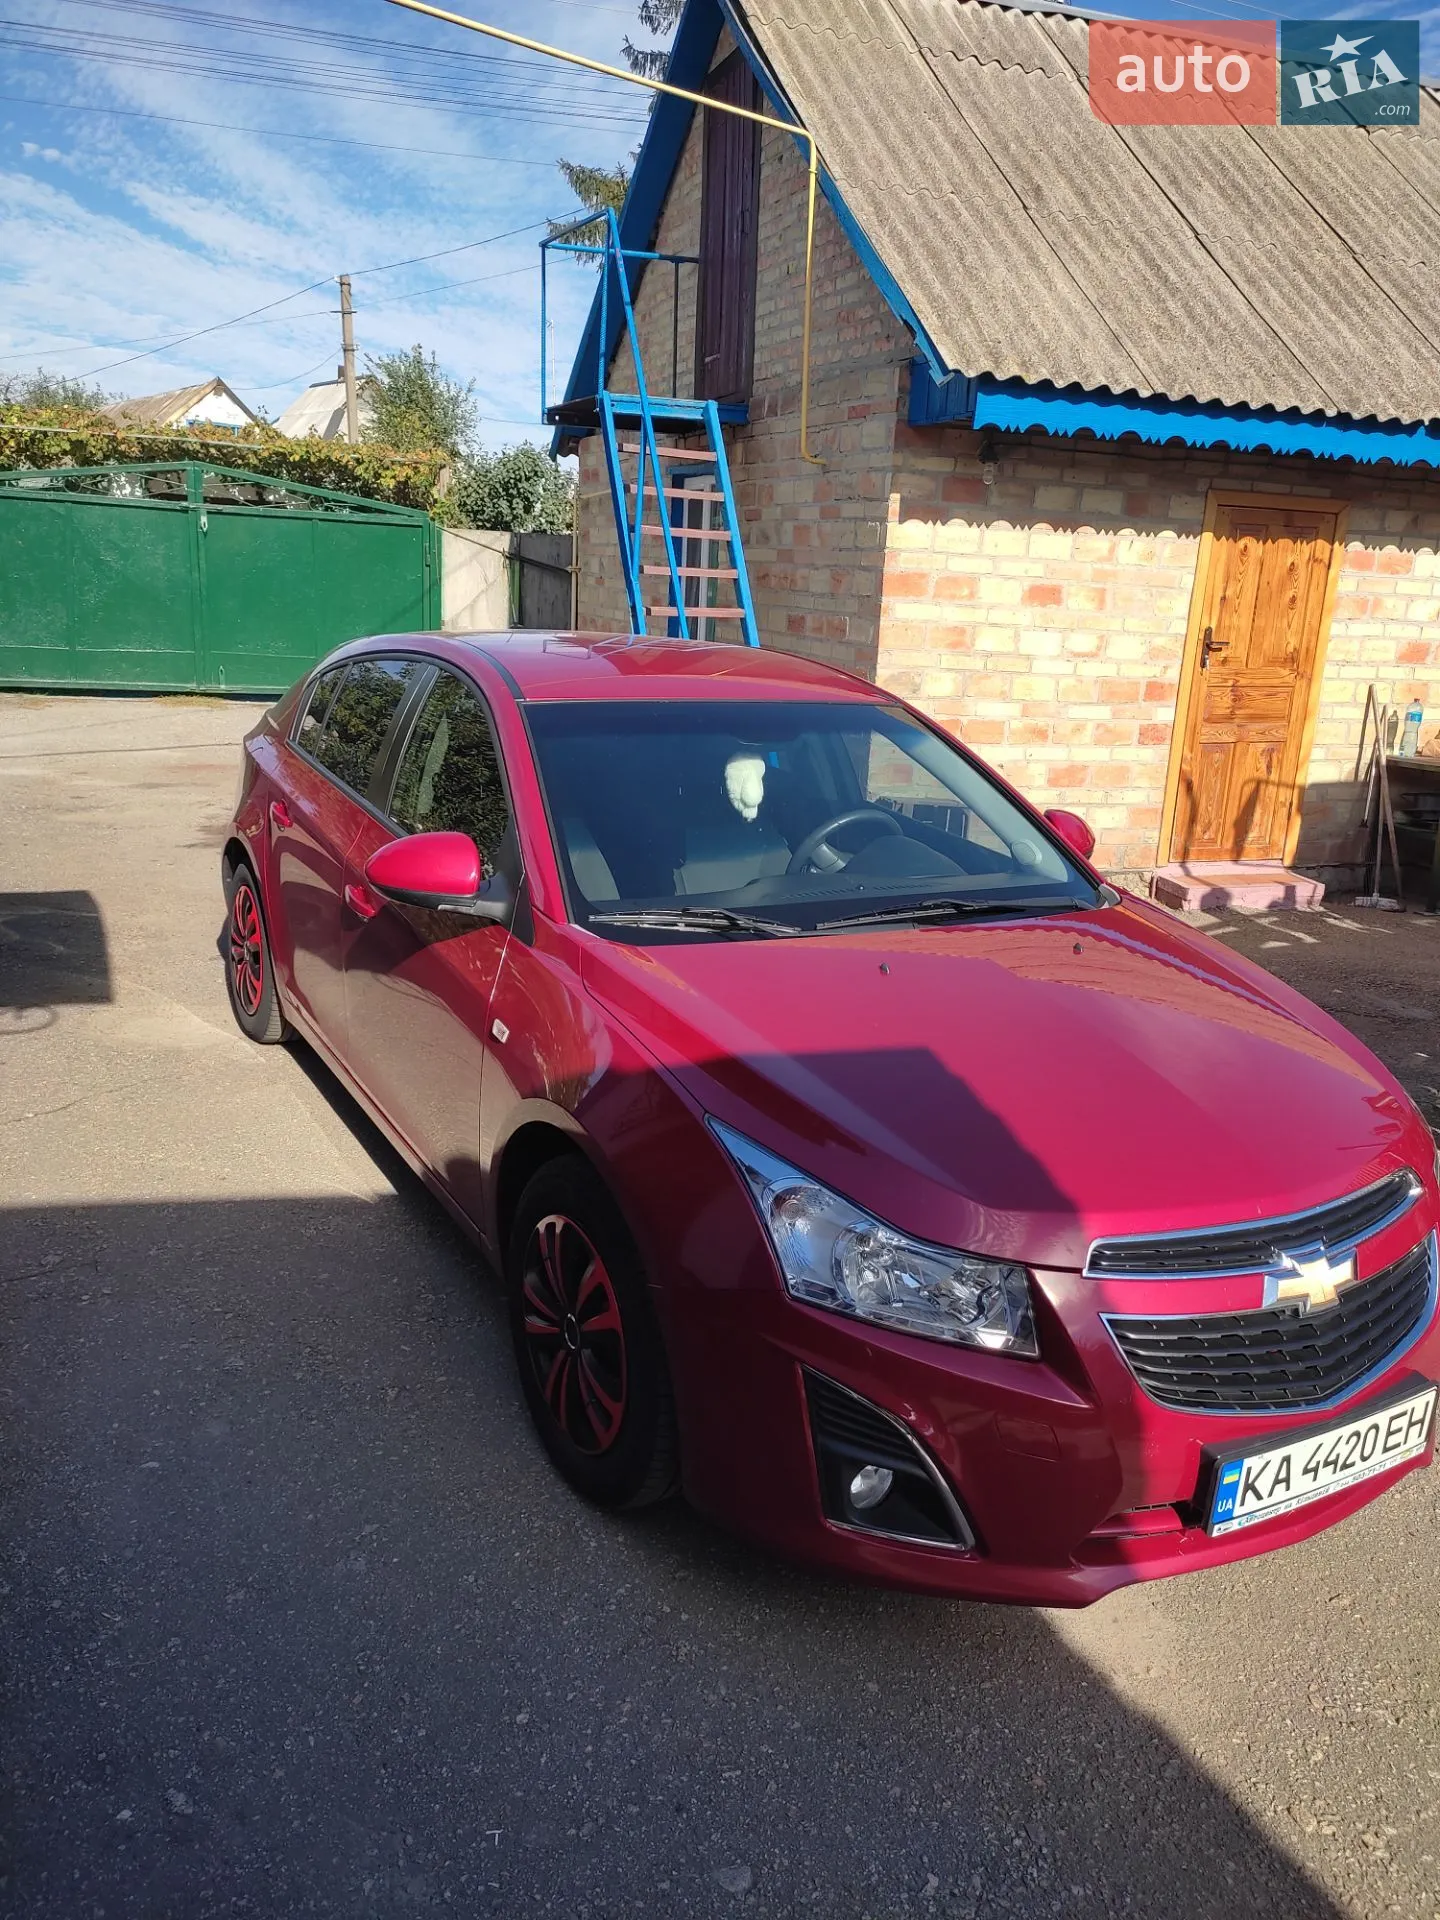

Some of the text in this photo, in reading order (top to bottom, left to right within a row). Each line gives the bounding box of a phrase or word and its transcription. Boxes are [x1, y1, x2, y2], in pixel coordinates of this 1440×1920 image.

[1239, 1454, 1291, 1507] KA
[1302, 1423, 1380, 1482] 4420
[1382, 1400, 1430, 1454] EH
[1217, 1498, 1233, 1513] UA
